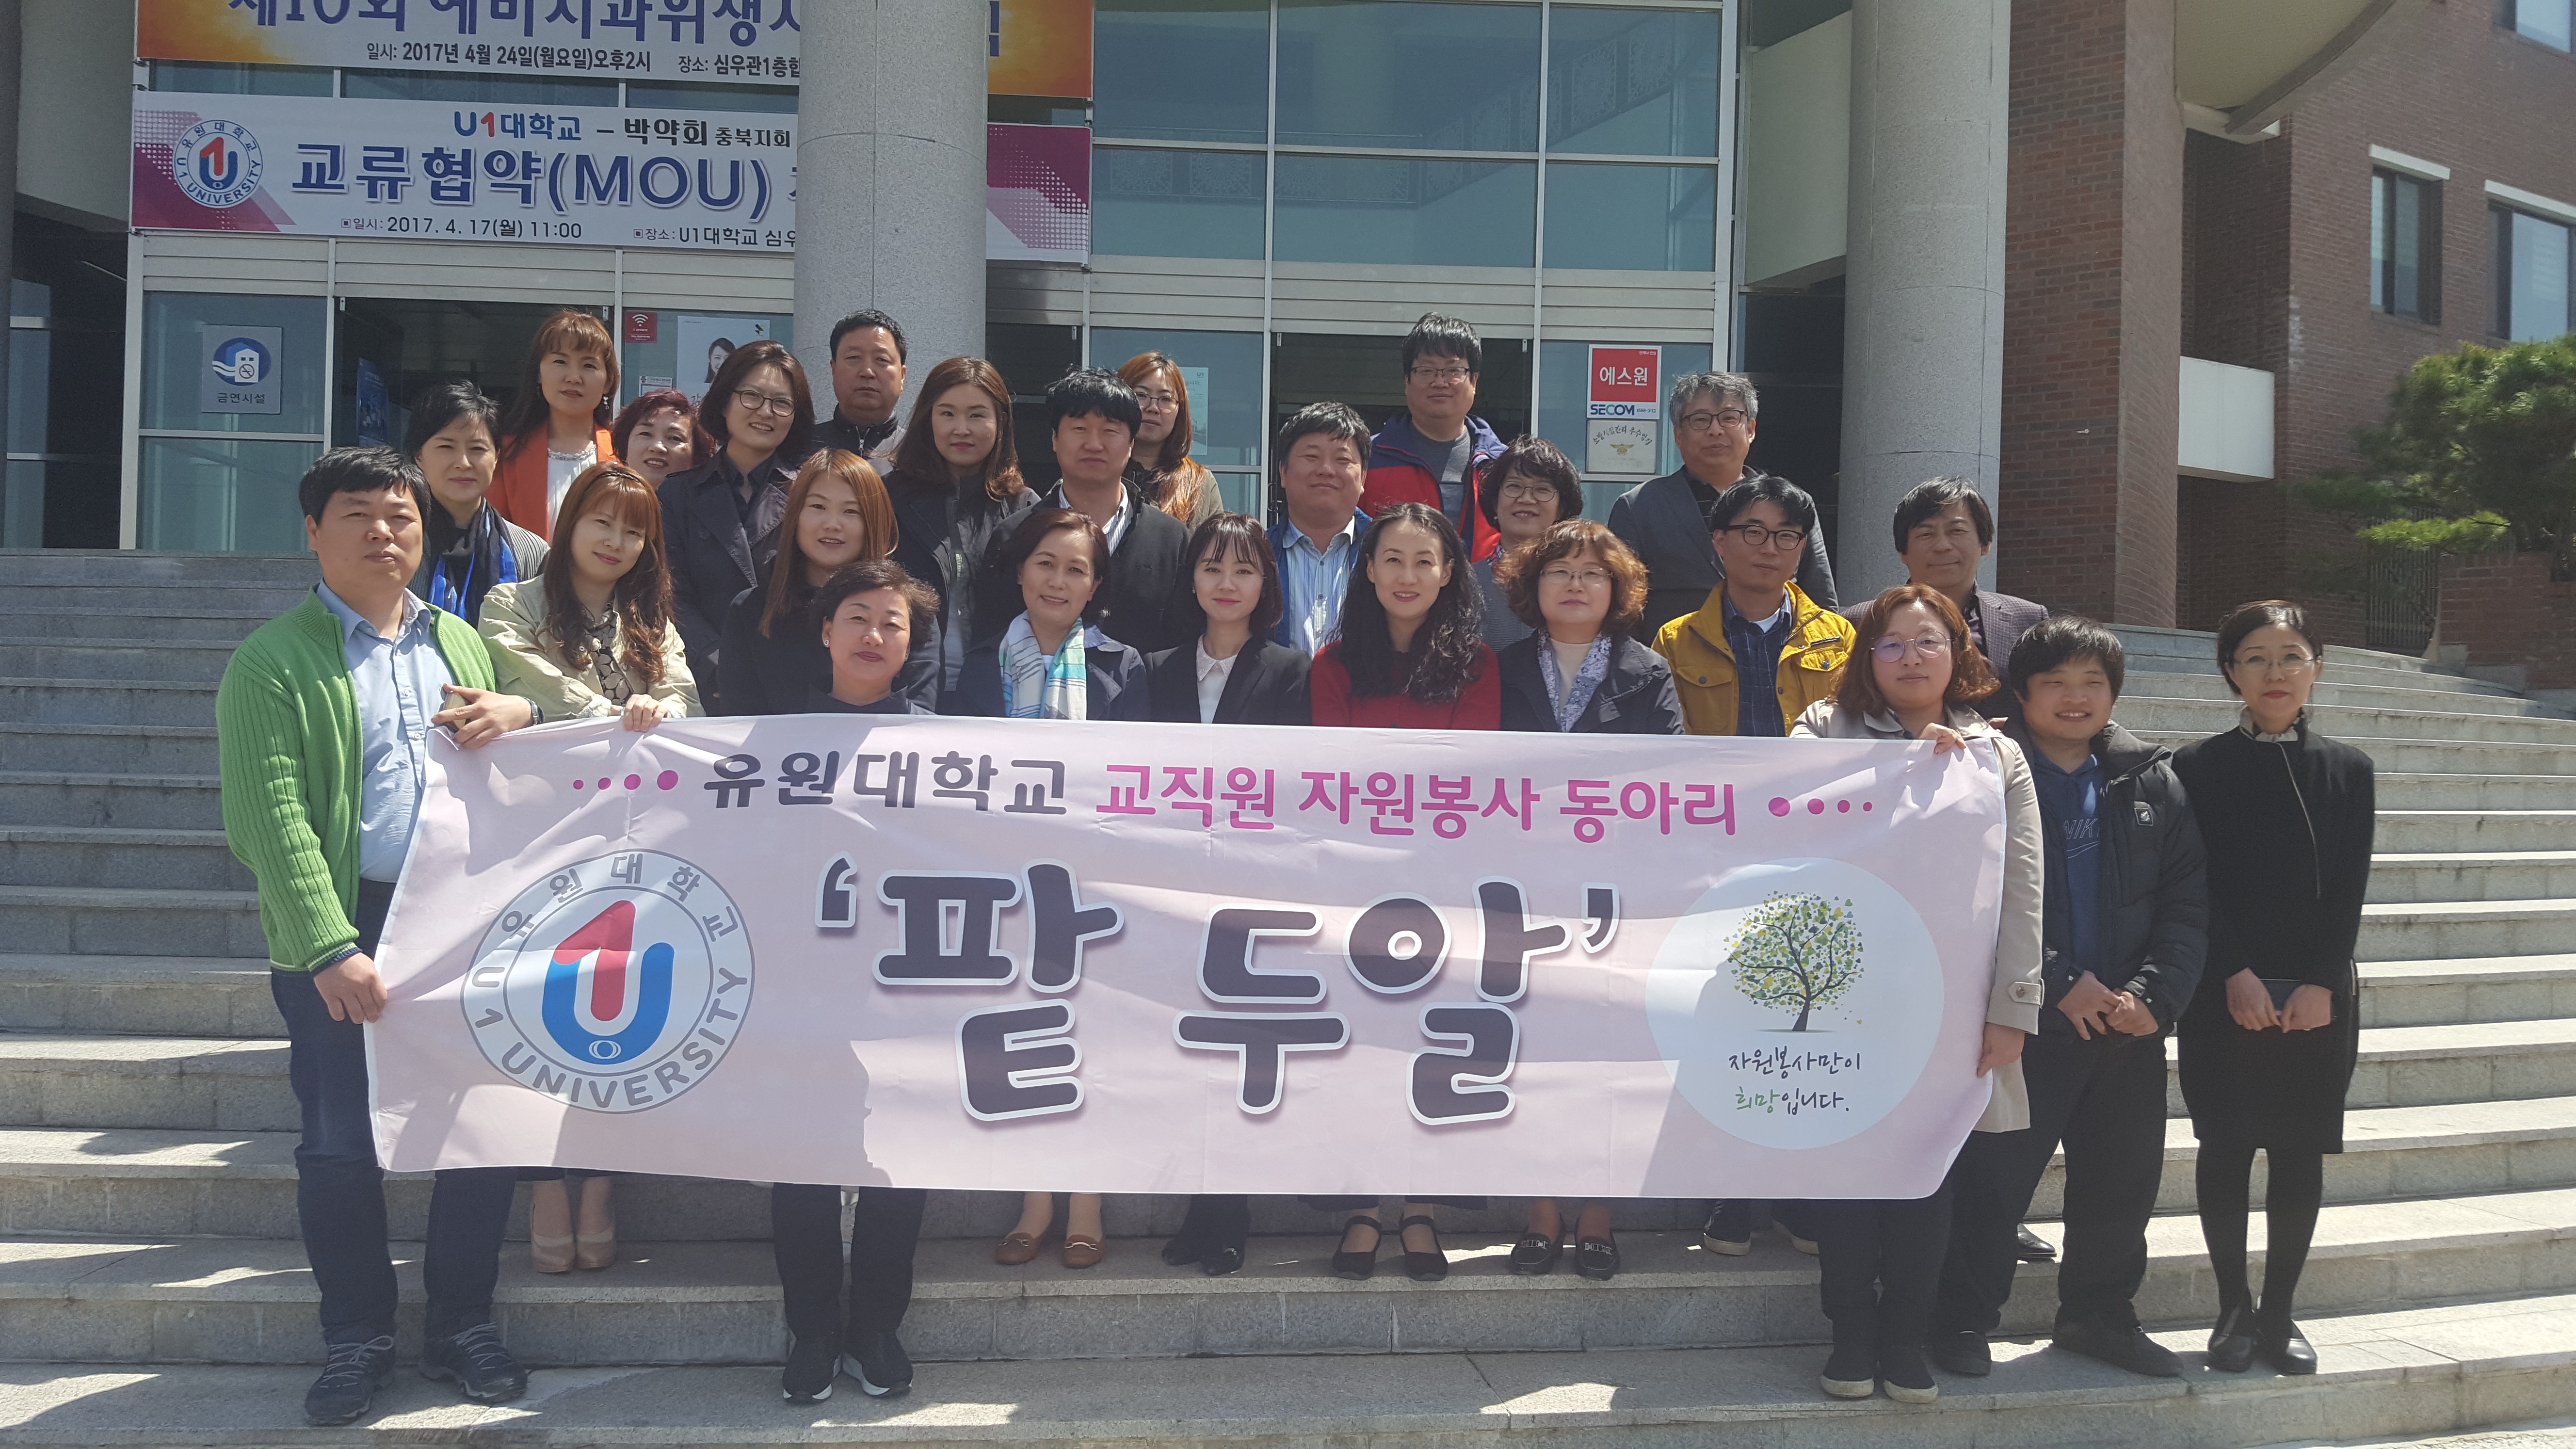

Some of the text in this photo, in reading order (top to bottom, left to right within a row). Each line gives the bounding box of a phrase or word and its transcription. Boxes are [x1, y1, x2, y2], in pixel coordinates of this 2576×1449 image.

[367, 43, 397, 61] 일시:
[402, 42, 458, 64] 2017년
[465, 44, 490, 65] 4월
[678, 55, 708, 73] 장소:
[454, 111, 581, 141] U1대학교
[625, 118, 707, 146] 박약회
[715, 127, 790, 147] 충북지회
[187, 160, 261, 204] UNIVERSITY
[292, 144, 768, 222] 교류협약(MOU)
[354, 217, 582, 238] 일시: 2017. 4. 17(월) 11:00
[645, 228, 675, 241] 장소:
[1599, 367, 1648, 386] 에스원
[217, 393, 265, 404] 금연시설
[1591, 404, 1635, 416] SECOM
[704, 750, 1737, 844] 유원대학교 교직원 자원봉사 동아리
[2064, 818, 2100, 839] NIK
[501, 853, 739, 942] 유원대학교
[501, 967, 749, 1109] UNIVERSITY
[1729, 1046, 1860, 1079] 자원봉사만이
[1735, 1086, 1849, 1116] 희망입니다.
